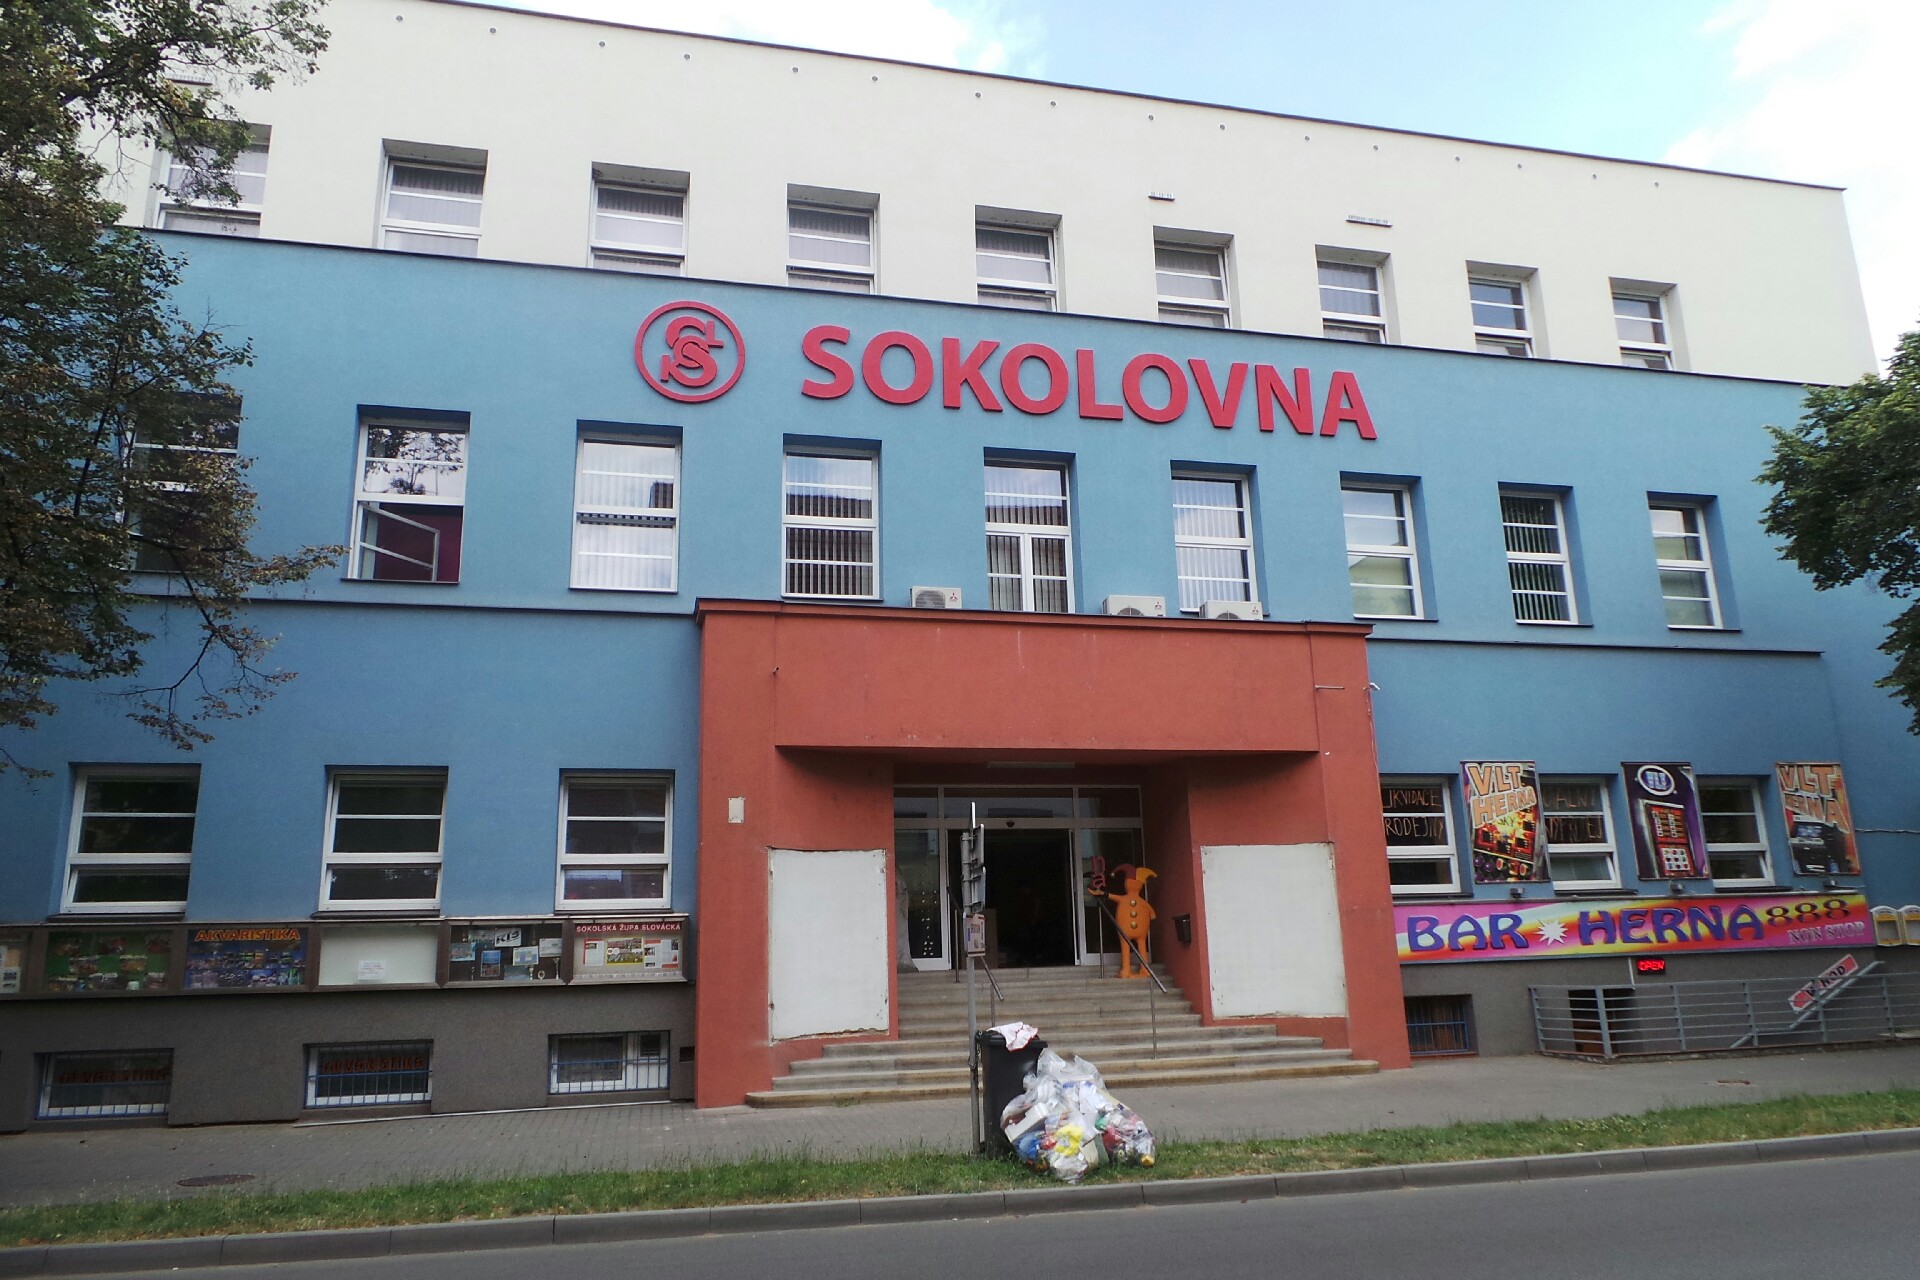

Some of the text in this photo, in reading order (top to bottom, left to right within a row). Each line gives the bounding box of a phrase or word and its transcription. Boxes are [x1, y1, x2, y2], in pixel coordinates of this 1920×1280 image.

[801, 325, 1377, 440] SOKOLOVNA
[1467, 764, 1522, 796] VLT
[1780, 765, 1836, 796] VLT
[1472, 787, 1536, 827] HERNA
[195, 928, 301, 942] AKVARISTIKA
[1407, 899, 1849, 951] BAR HERNA 888
[1788, 921, 1865, 944] NON STOP
[1638, 960, 1665, 972] OPEN
